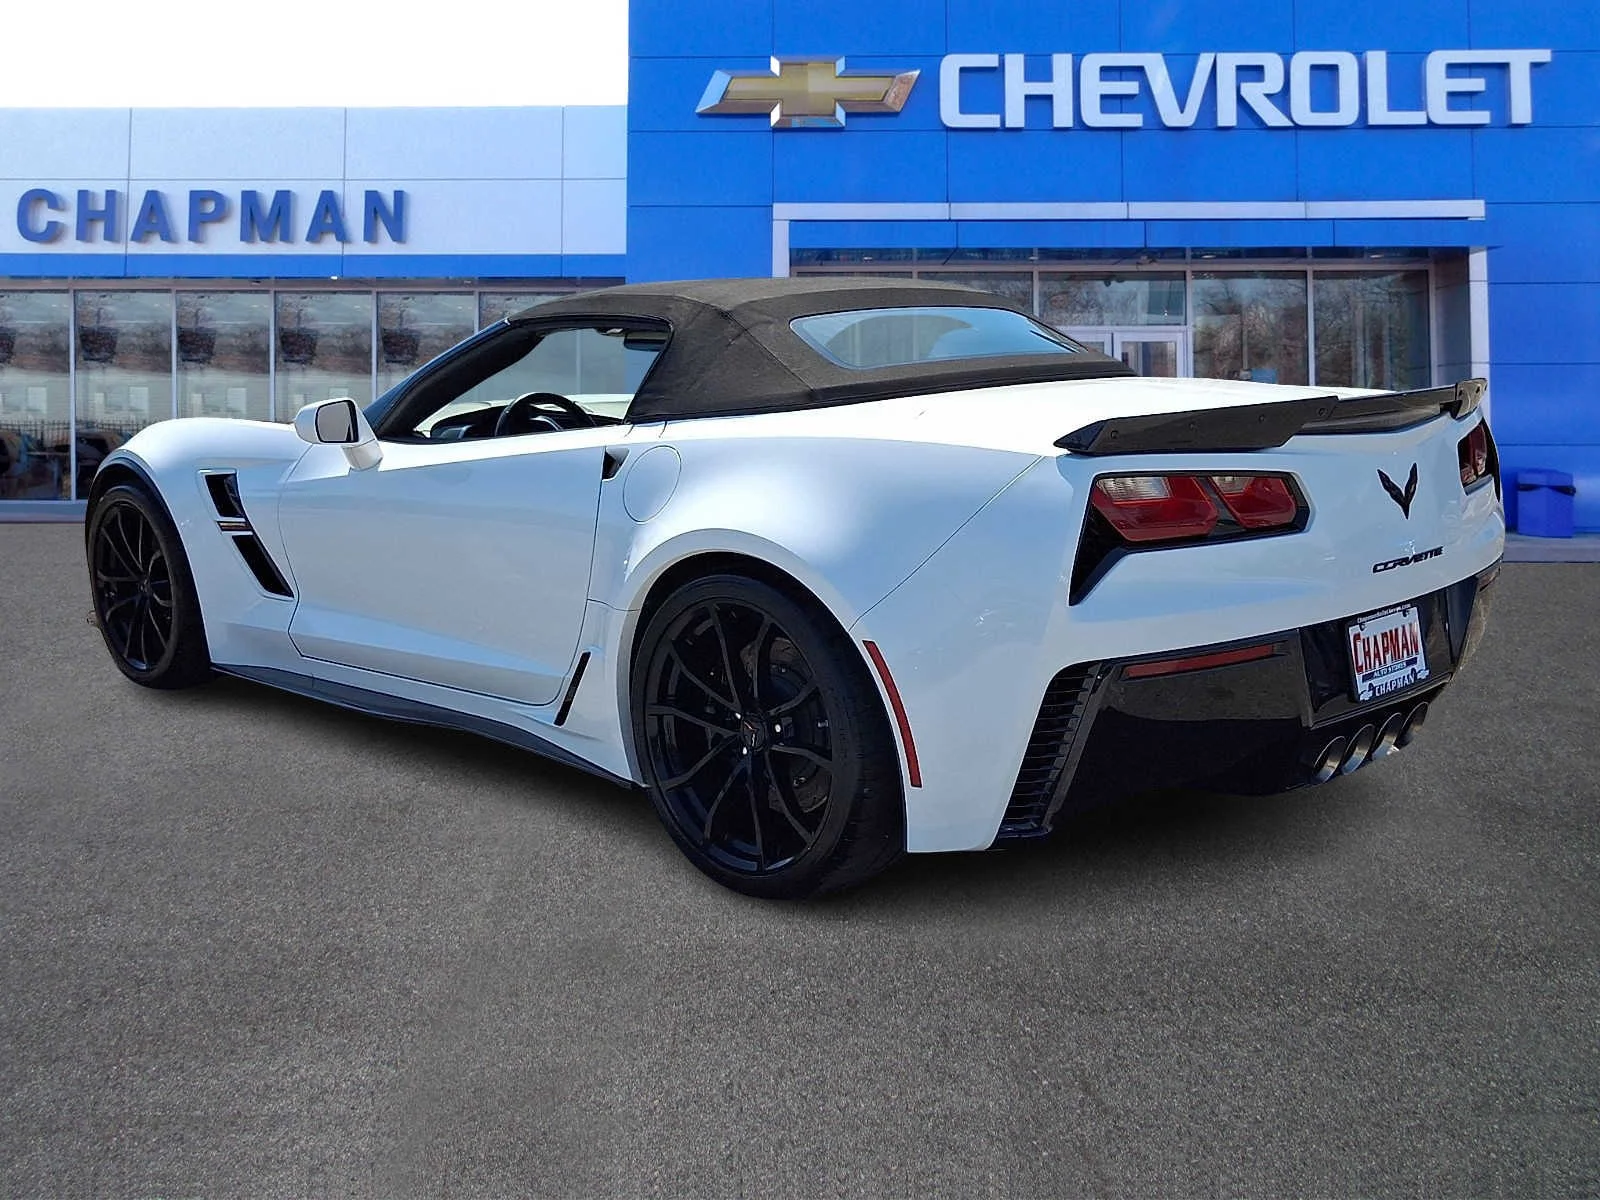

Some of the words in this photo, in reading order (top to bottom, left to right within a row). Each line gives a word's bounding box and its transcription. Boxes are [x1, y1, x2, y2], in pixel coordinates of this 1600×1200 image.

[939, 49, 1552, 129] CHEVROLET
[17, 188, 407, 243] CHAPMAN
[1372, 546, 1443, 573] CORVETTE
[1353, 622, 1419, 673] CHAPMAN
[1375, 673, 1415, 696] CHAPMAN
